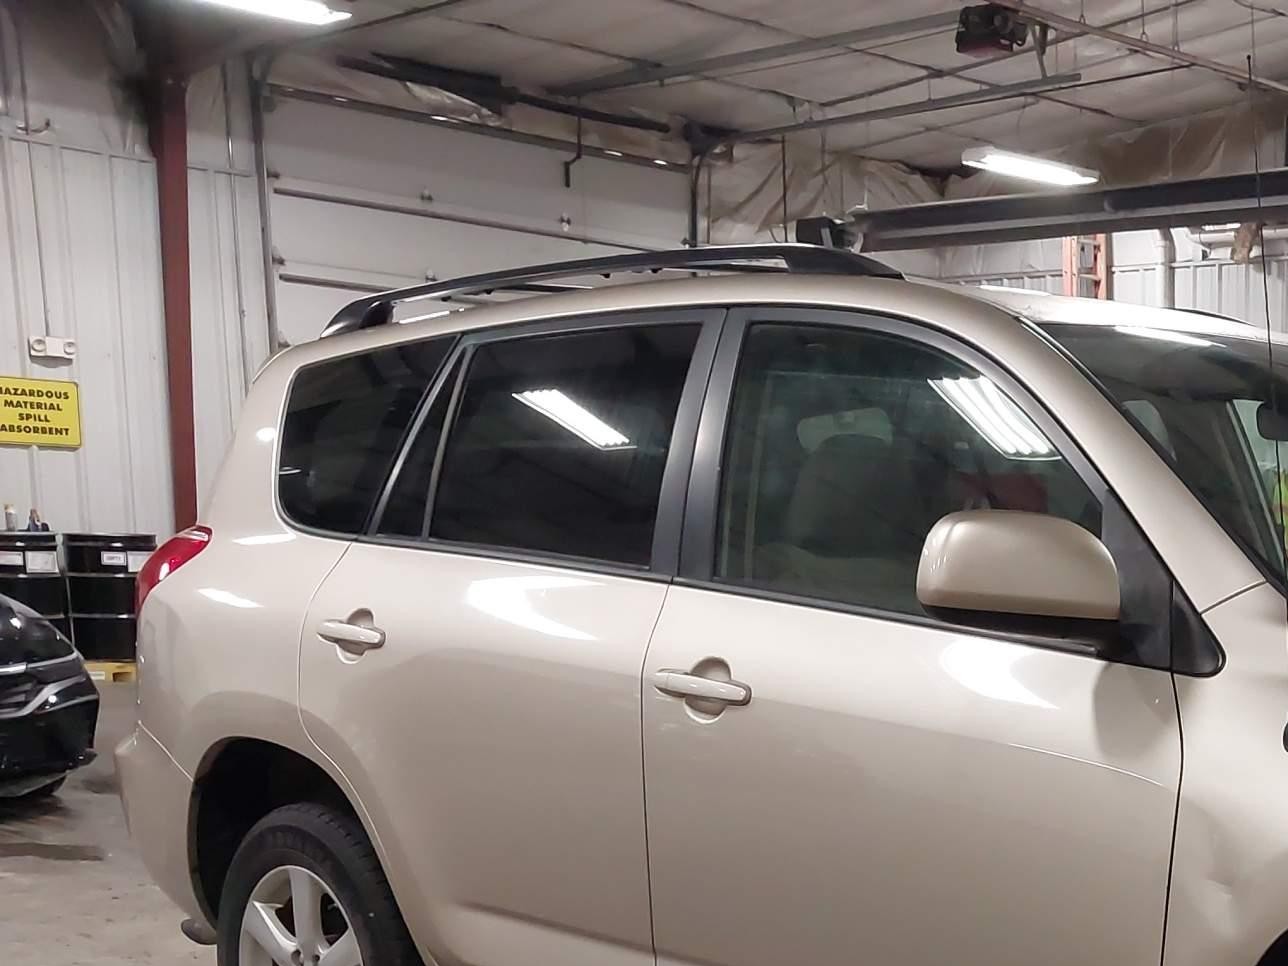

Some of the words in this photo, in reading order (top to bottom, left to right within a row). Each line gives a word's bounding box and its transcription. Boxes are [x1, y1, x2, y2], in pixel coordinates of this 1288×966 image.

[4, 399, 63, 411] MATERIAL
[18, 413, 50, 422] SPILL
[0, 424, 69, 436] ABSORBENT
